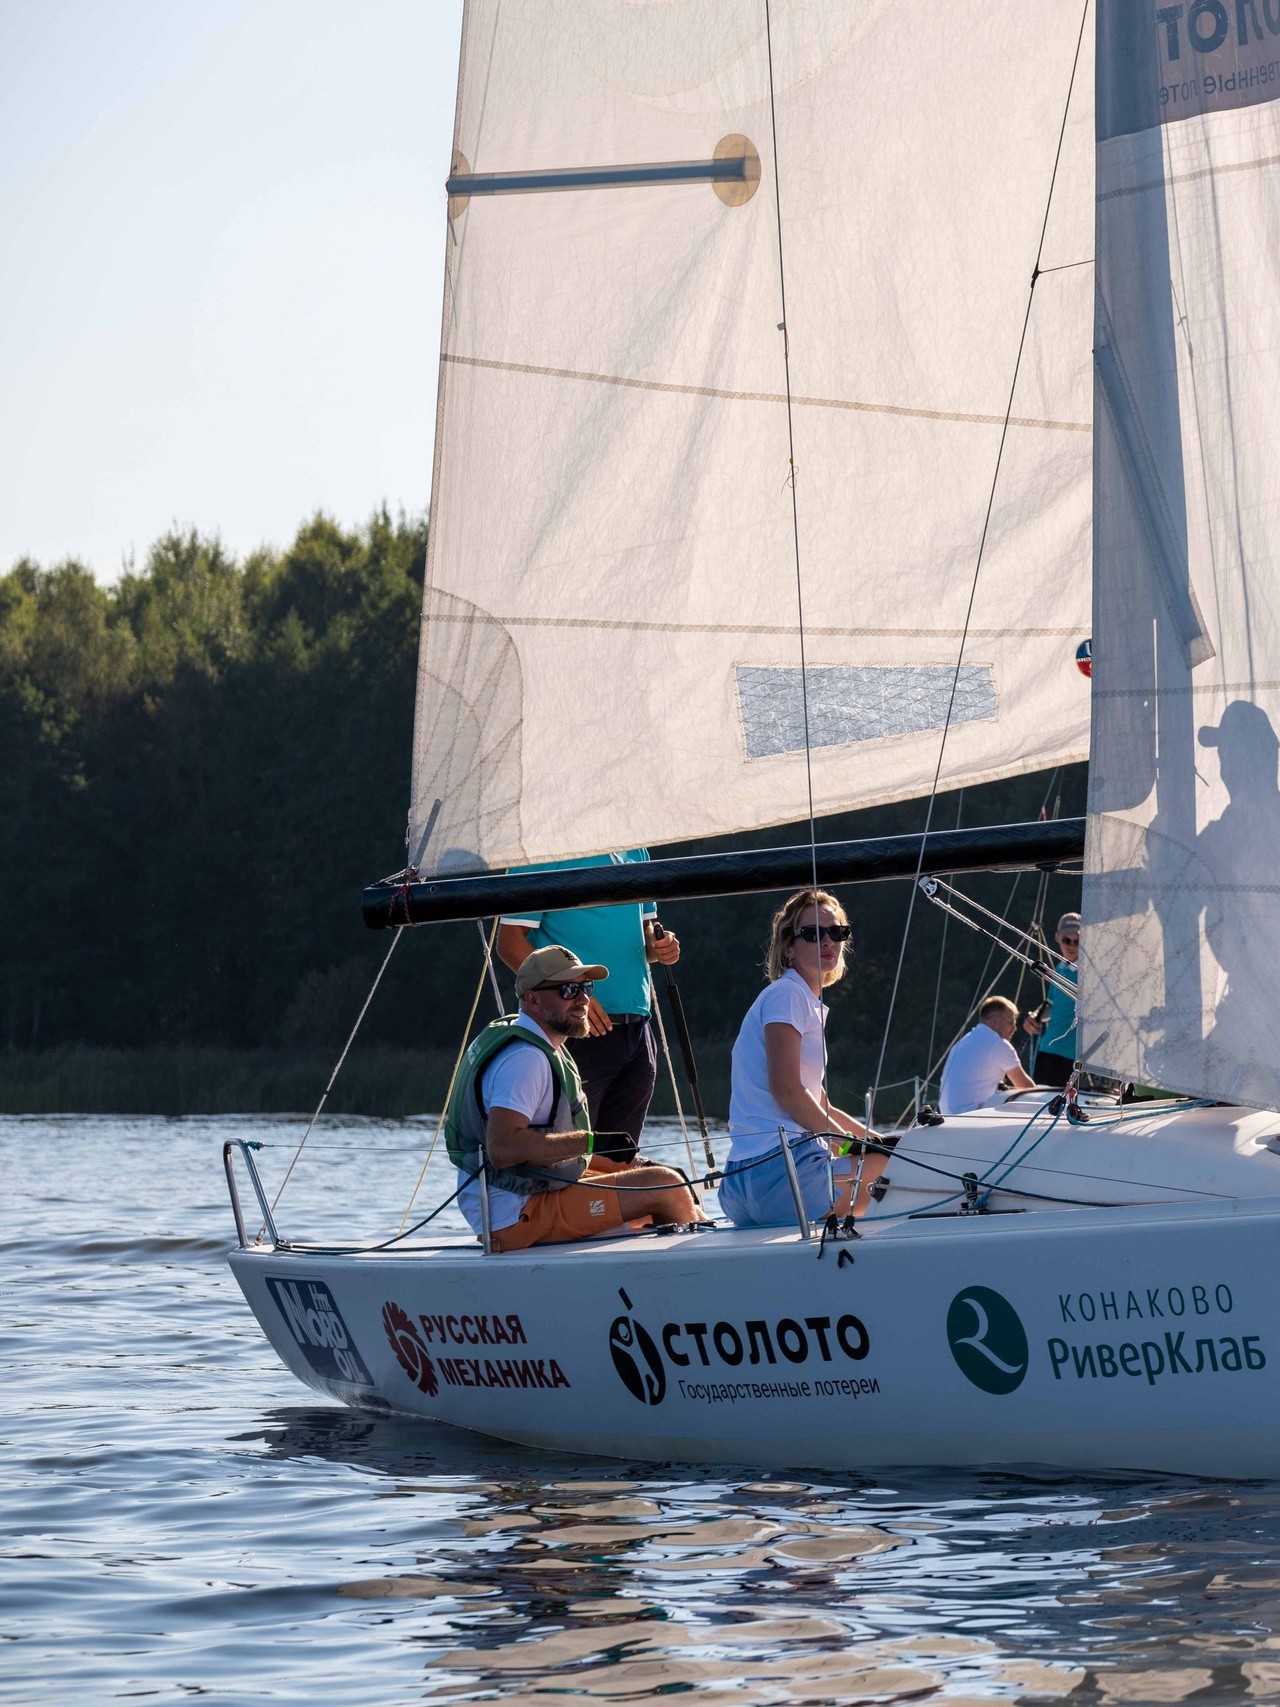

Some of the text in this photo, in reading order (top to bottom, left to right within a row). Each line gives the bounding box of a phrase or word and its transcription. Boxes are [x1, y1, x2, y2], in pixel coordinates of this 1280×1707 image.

[274, 1281, 348, 1350] NORD
[1058, 1283, 1234, 1323] КОНАКОВО
[418, 1314, 528, 1345] РУССКАЯ
[661, 1314, 870, 1367] СТОЛОТО
[333, 1347, 368, 1384] OIL
[436, 1357, 572, 1389] МЕХАНИКА
[1047, 1331, 1267, 1386] РиверКлаб
[677, 1378, 881, 1405] Государственные лотереи
